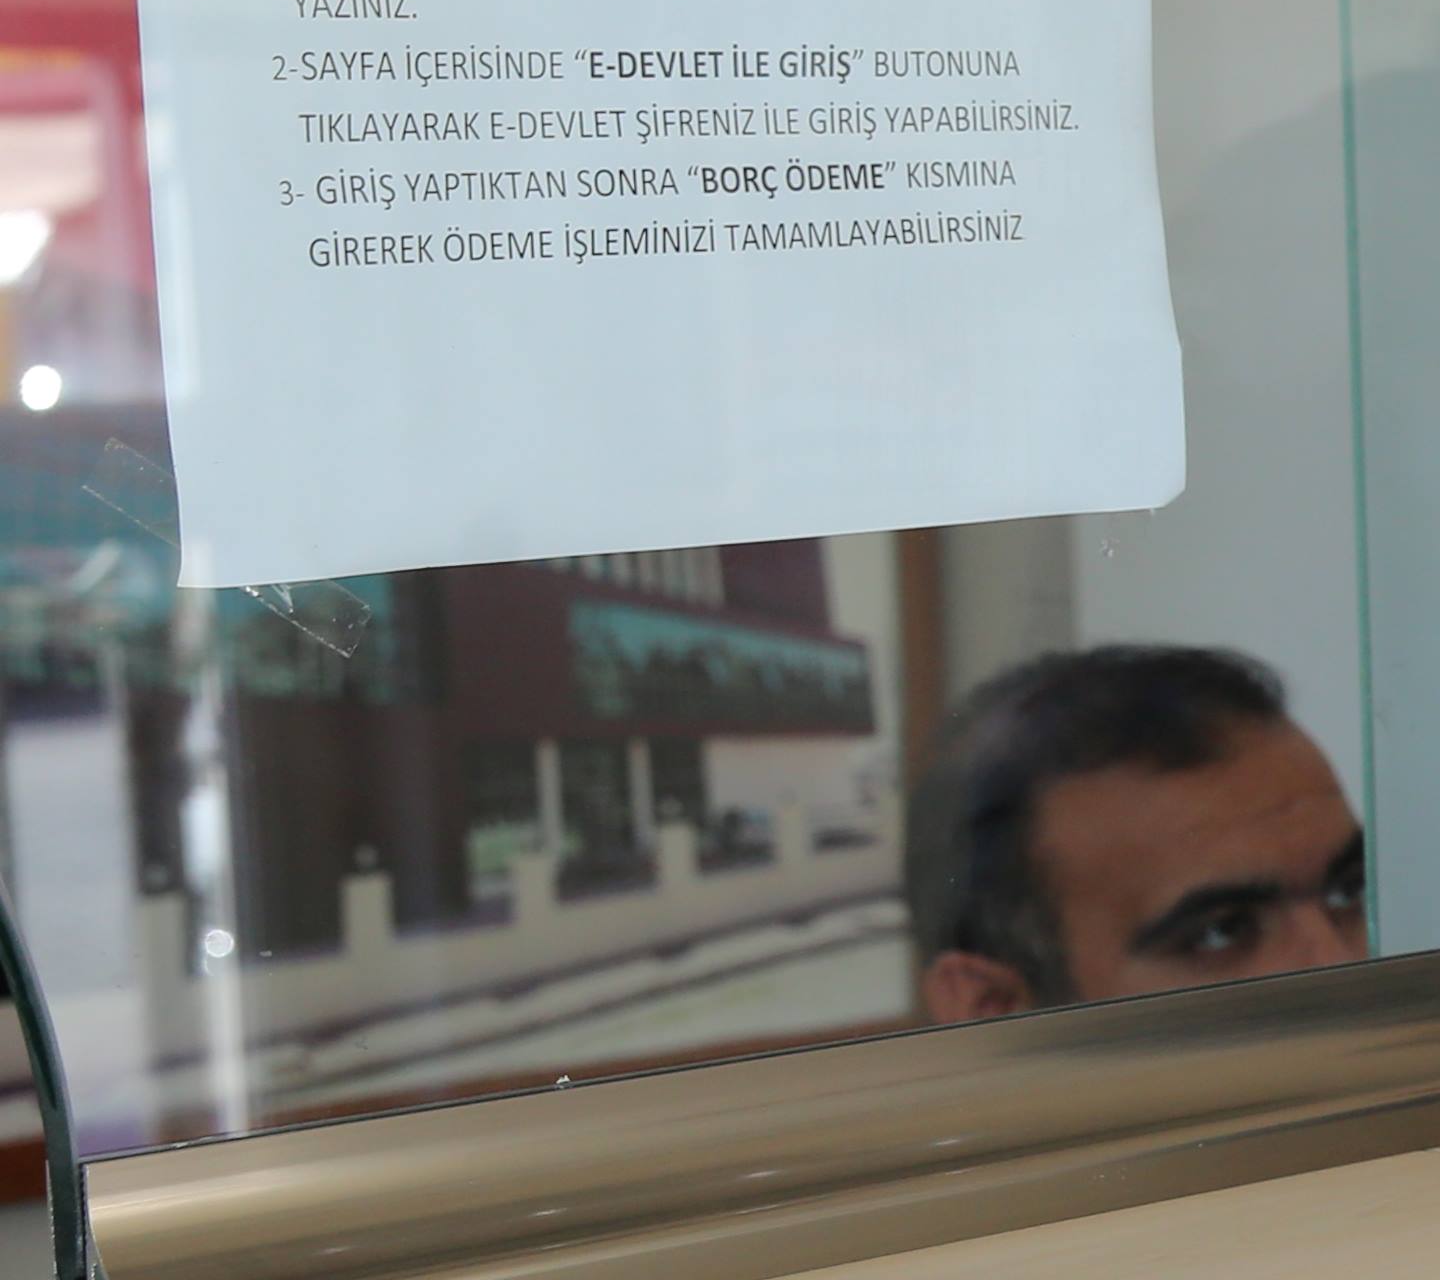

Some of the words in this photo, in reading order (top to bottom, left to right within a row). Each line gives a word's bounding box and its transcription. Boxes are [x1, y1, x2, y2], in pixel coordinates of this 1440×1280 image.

[405, 44, 565, 88] İÇERİSİNDE
[732, 43, 771, 78] İLE
[874, 50, 1020, 78] BUTONUNA
[297, 111, 481, 143] TIKLAYARAK
[490, 109, 627, 140] E-DEVLET
[635, 102, 757, 145] ŞİFRENİZ
[763, 101, 801, 135] İLE
[808, 100, 877, 140] GİRİŞ
[884, 98, 1079, 133] YAPABİLİRSİNİZ.
[315, 167, 396, 210] GİRİŞ
[403, 169, 567, 203] YAPTIKTAN
[576, 167, 680, 198] SONRA
[906, 159, 1017, 189] KISMINA
[308, 230, 435, 268] GİREREK
[443, 226, 555, 263] ÖDEME
[564, 218, 716, 265] İŞLEMİNİZİ
[723, 208, 1024, 252] TAMAMLAYABİLİRSİNİZ
